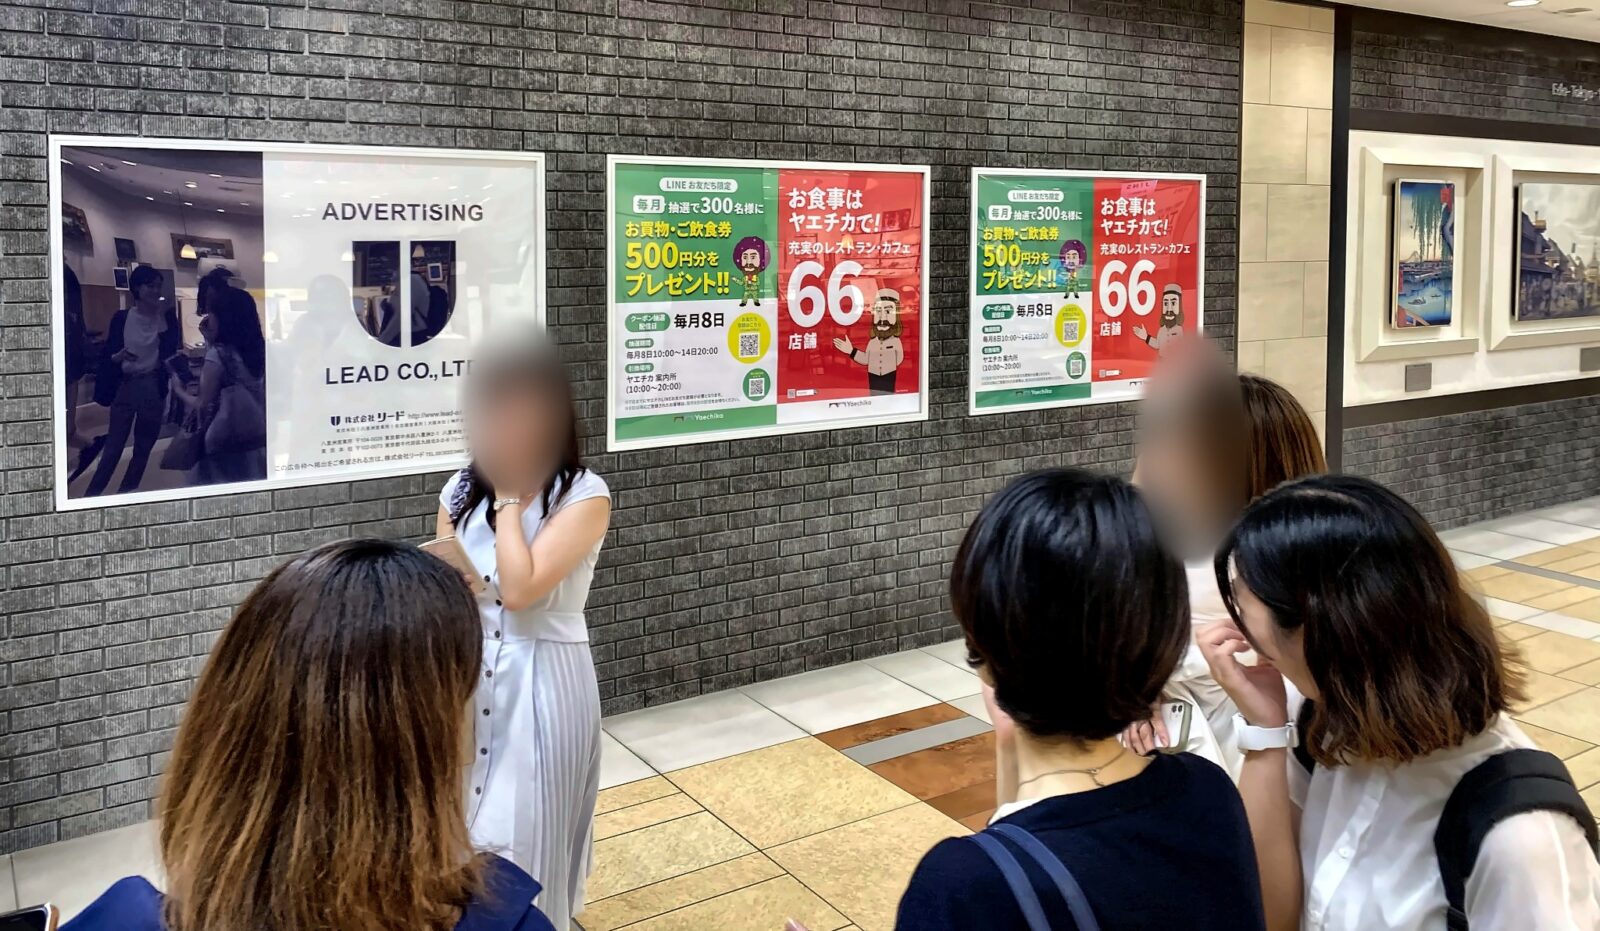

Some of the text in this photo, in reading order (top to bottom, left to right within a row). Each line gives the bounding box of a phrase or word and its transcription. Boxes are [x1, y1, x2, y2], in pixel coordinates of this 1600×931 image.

[666, 181, 732, 190] LINE お友だち限定
[636, 197, 764, 214] 毎月 抽選で300名様に
[789, 187, 863, 210] お食事は
[1101, 197, 1156, 216] お食事は
[322, 202, 484, 222] ADVERTISING
[991, 206, 1083, 220] 毎月 抽選で300名様に
[625, 221, 732, 238] お買物・ご飲食券
[789, 212, 880, 233] ヤエチカで!
[983, 226, 1059, 240] お買物・ご飲食券
[625, 241, 719, 269] 500円分を
[788, 241, 911, 255] 充実のレストラン・カフェ
[983, 243, 1049, 267] 500円分を
[1100, 242, 1190, 254] 充実のレストラン・カフェ
[625, 271, 729, 296] プレゼント!!
[1099, 259, 1156, 318] 66
[787, 260, 864, 328] 66
[1016, 303, 1052, 317] 毎月8日
[674, 312, 724, 329] 毎月8日
[1100, 322, 1122, 337] 店舗
[788, 333, 817, 350] 店舗
[326, 360, 474, 385] LEAD CO.,LT
[627, 373, 677, 383] ヤエチカ 案内所
[345, 414, 374, 423] 株式会社
[377, 411, 405, 422] リード
